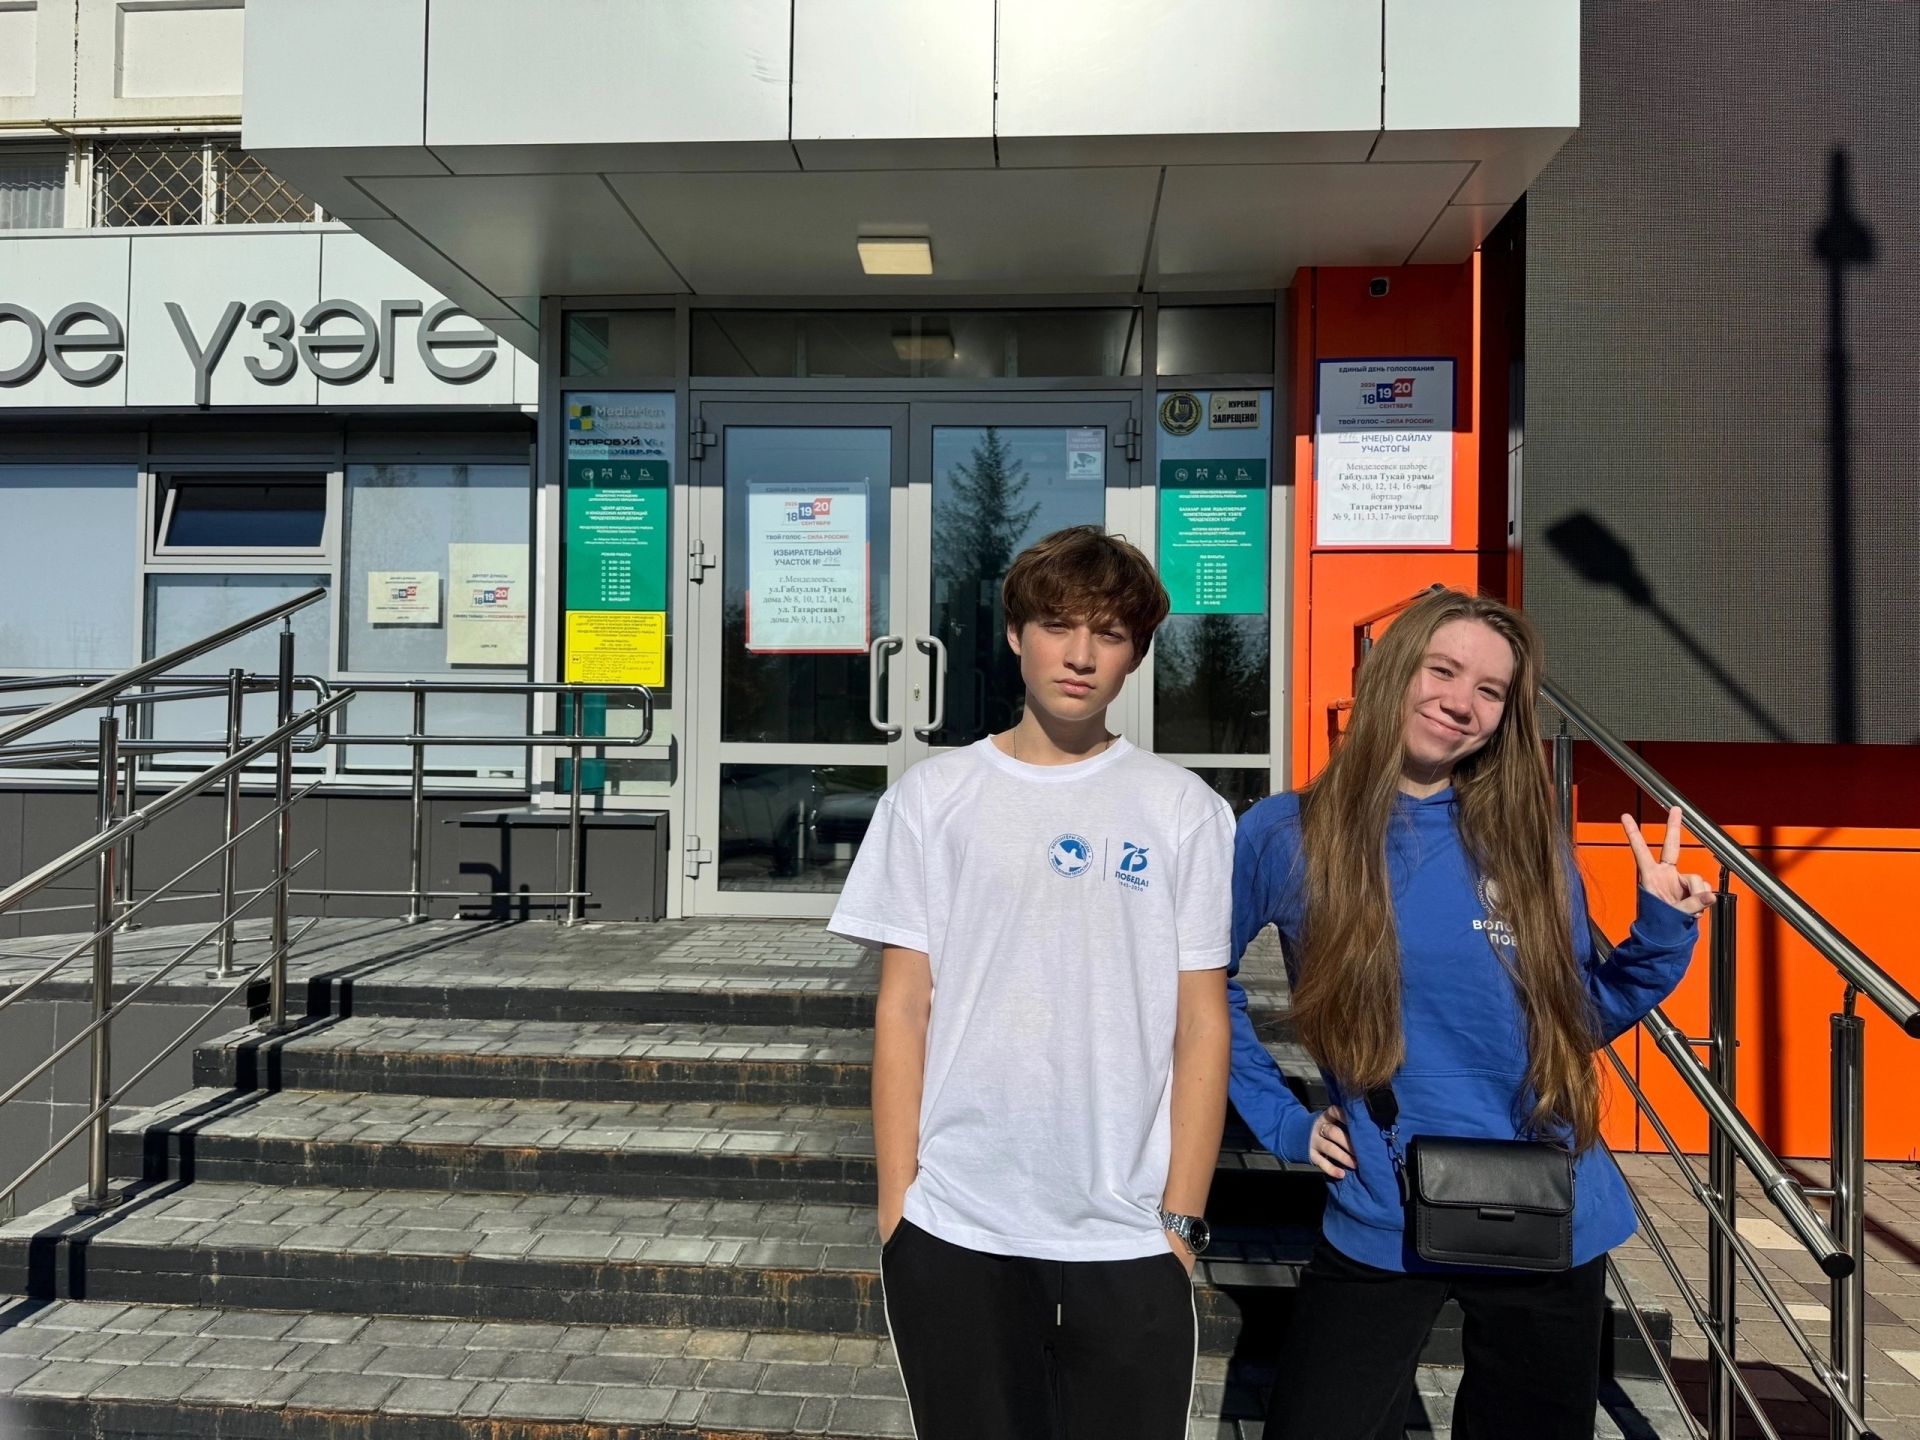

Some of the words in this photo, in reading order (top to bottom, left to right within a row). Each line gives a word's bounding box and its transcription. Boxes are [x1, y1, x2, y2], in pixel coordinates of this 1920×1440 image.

[1362, 394, 1376, 404] 18
[1378, 388, 1392, 398] 19
[1394, 383, 1411, 393] 20
[1228, 400, 1257, 408] КУРЕНИЕ
[1212, 413, 1257, 424] ЗАПРЕЩЕНО!
[569, 436, 640, 446] ПОПРОБУЙ
[1361, 434, 1393, 444] НЧЕ(Ы)
[1395, 433, 1432, 442] САЙЛАУ
[1362, 445, 1410, 453] УЧАСТОГЫ
[1346, 463, 1398, 471] Менделеевск
[1339, 473, 1377, 481] Габдулла
[1380, 473, 1405, 481] Тукай
[1362, 483, 1373, 491] 10,
[1376, 483, 1386, 491] 12,
[1389, 483, 1400, 491] 14,
[1371, 492, 1402, 501] йортлар
[1350, 503, 1392, 511] Татарстан
[786, 512, 798, 522] 18
[800, 507, 812, 516] 19
[814, 502, 829, 512] 20
[1343, 513, 1350, 521] 9,
[1353, 513, 1365, 521] 11,
[1367, 513, 1378, 521] 13,
[1408, 513, 1438, 522] йортлар
[774, 548, 842, 556] ИЗБИРАТЕЛЬНЫЙ
[775, 558, 812, 566] УЧАСТОК
[485, 593, 494, 601] 19
[496, 589, 507, 597] 20
[822, 586, 847, 595] Тукая
[803, 595, 814, 603] 10,
[816, 595, 826, 603] 12,
[829, 595, 840, 603] 14,
[778, 607, 789, 615] ул.
[791, 606, 837, 614] Татарстана
[811, 616, 821, 624] 11,
[824, 616, 835, 624] 13,
[1115, 870, 1149, 887] ПОБЕДА!
